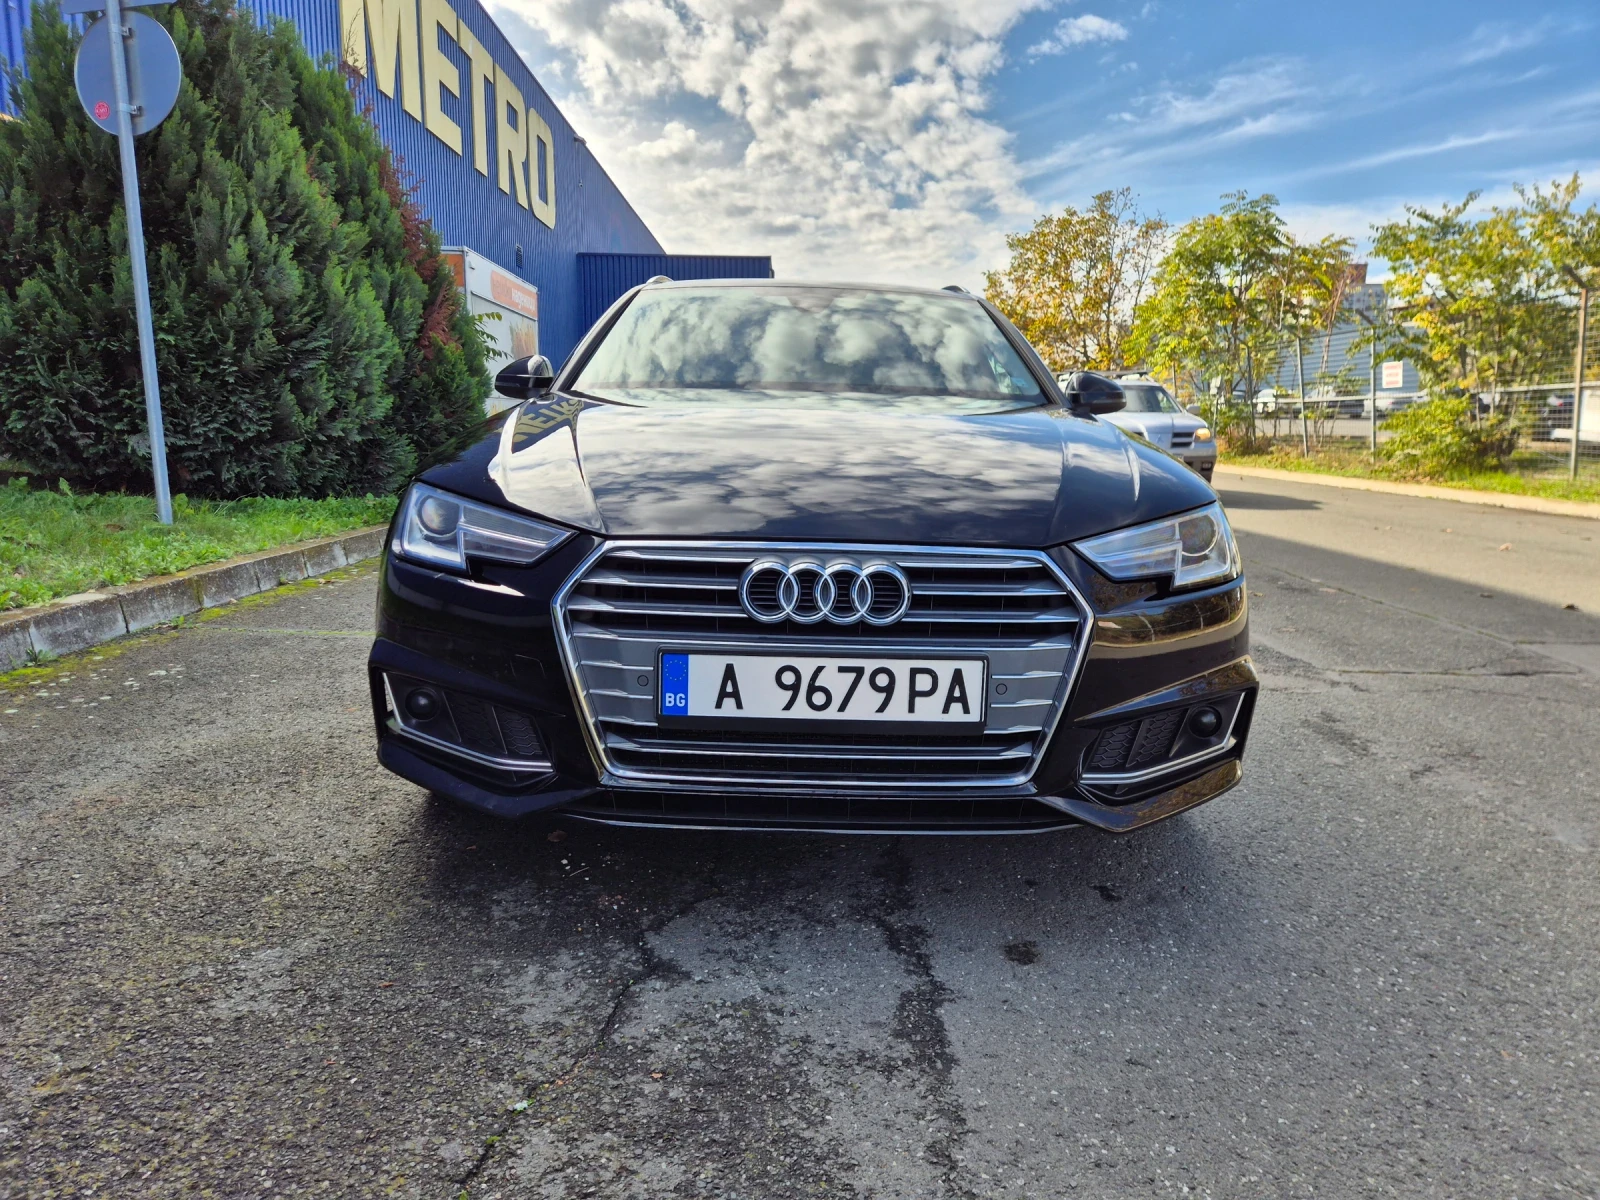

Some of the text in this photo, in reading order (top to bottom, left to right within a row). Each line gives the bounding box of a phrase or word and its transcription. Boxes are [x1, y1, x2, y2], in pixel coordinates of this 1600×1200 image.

[340, 0, 556, 230] METRO
[665, 693, 686, 707] BG
[714, 663, 744, 709] A
